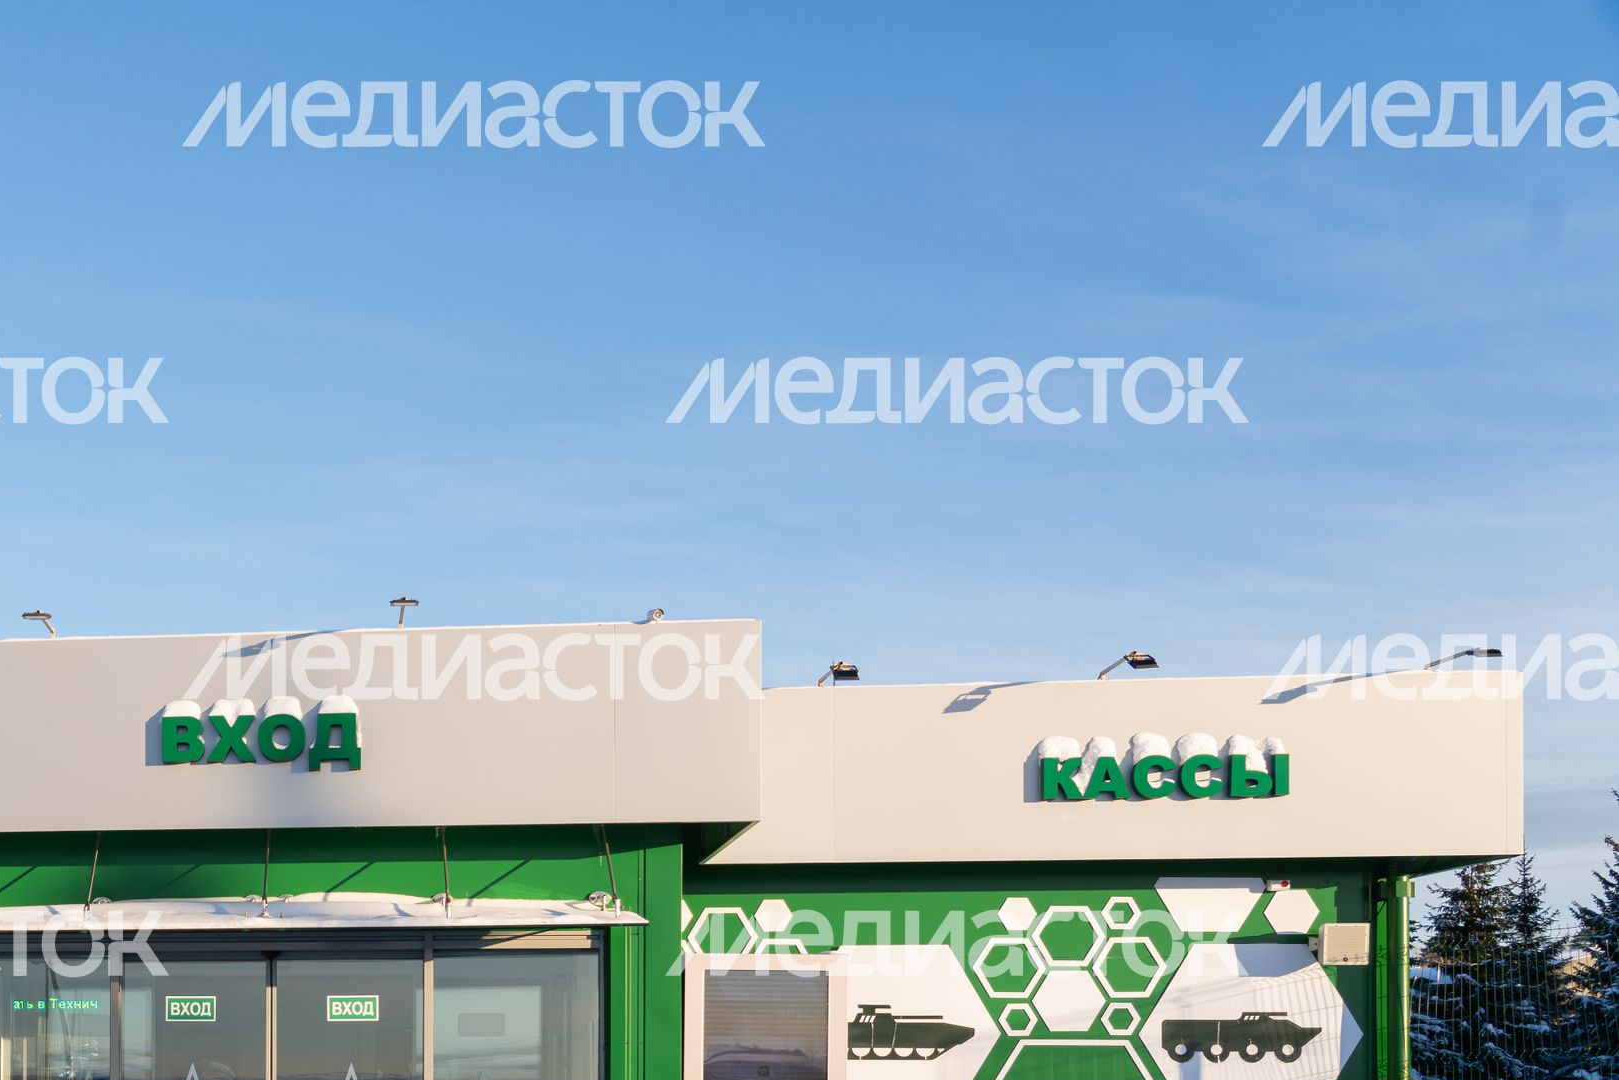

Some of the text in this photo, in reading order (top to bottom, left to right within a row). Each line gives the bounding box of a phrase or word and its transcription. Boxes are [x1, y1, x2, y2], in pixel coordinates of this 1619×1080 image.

[162, 713, 361, 771] ВХОД
[1041, 754, 1289, 800] КАССЫ
[170, 1002, 212, 1016] ВХОД
[332, 1001, 374, 1016] ВХОД
